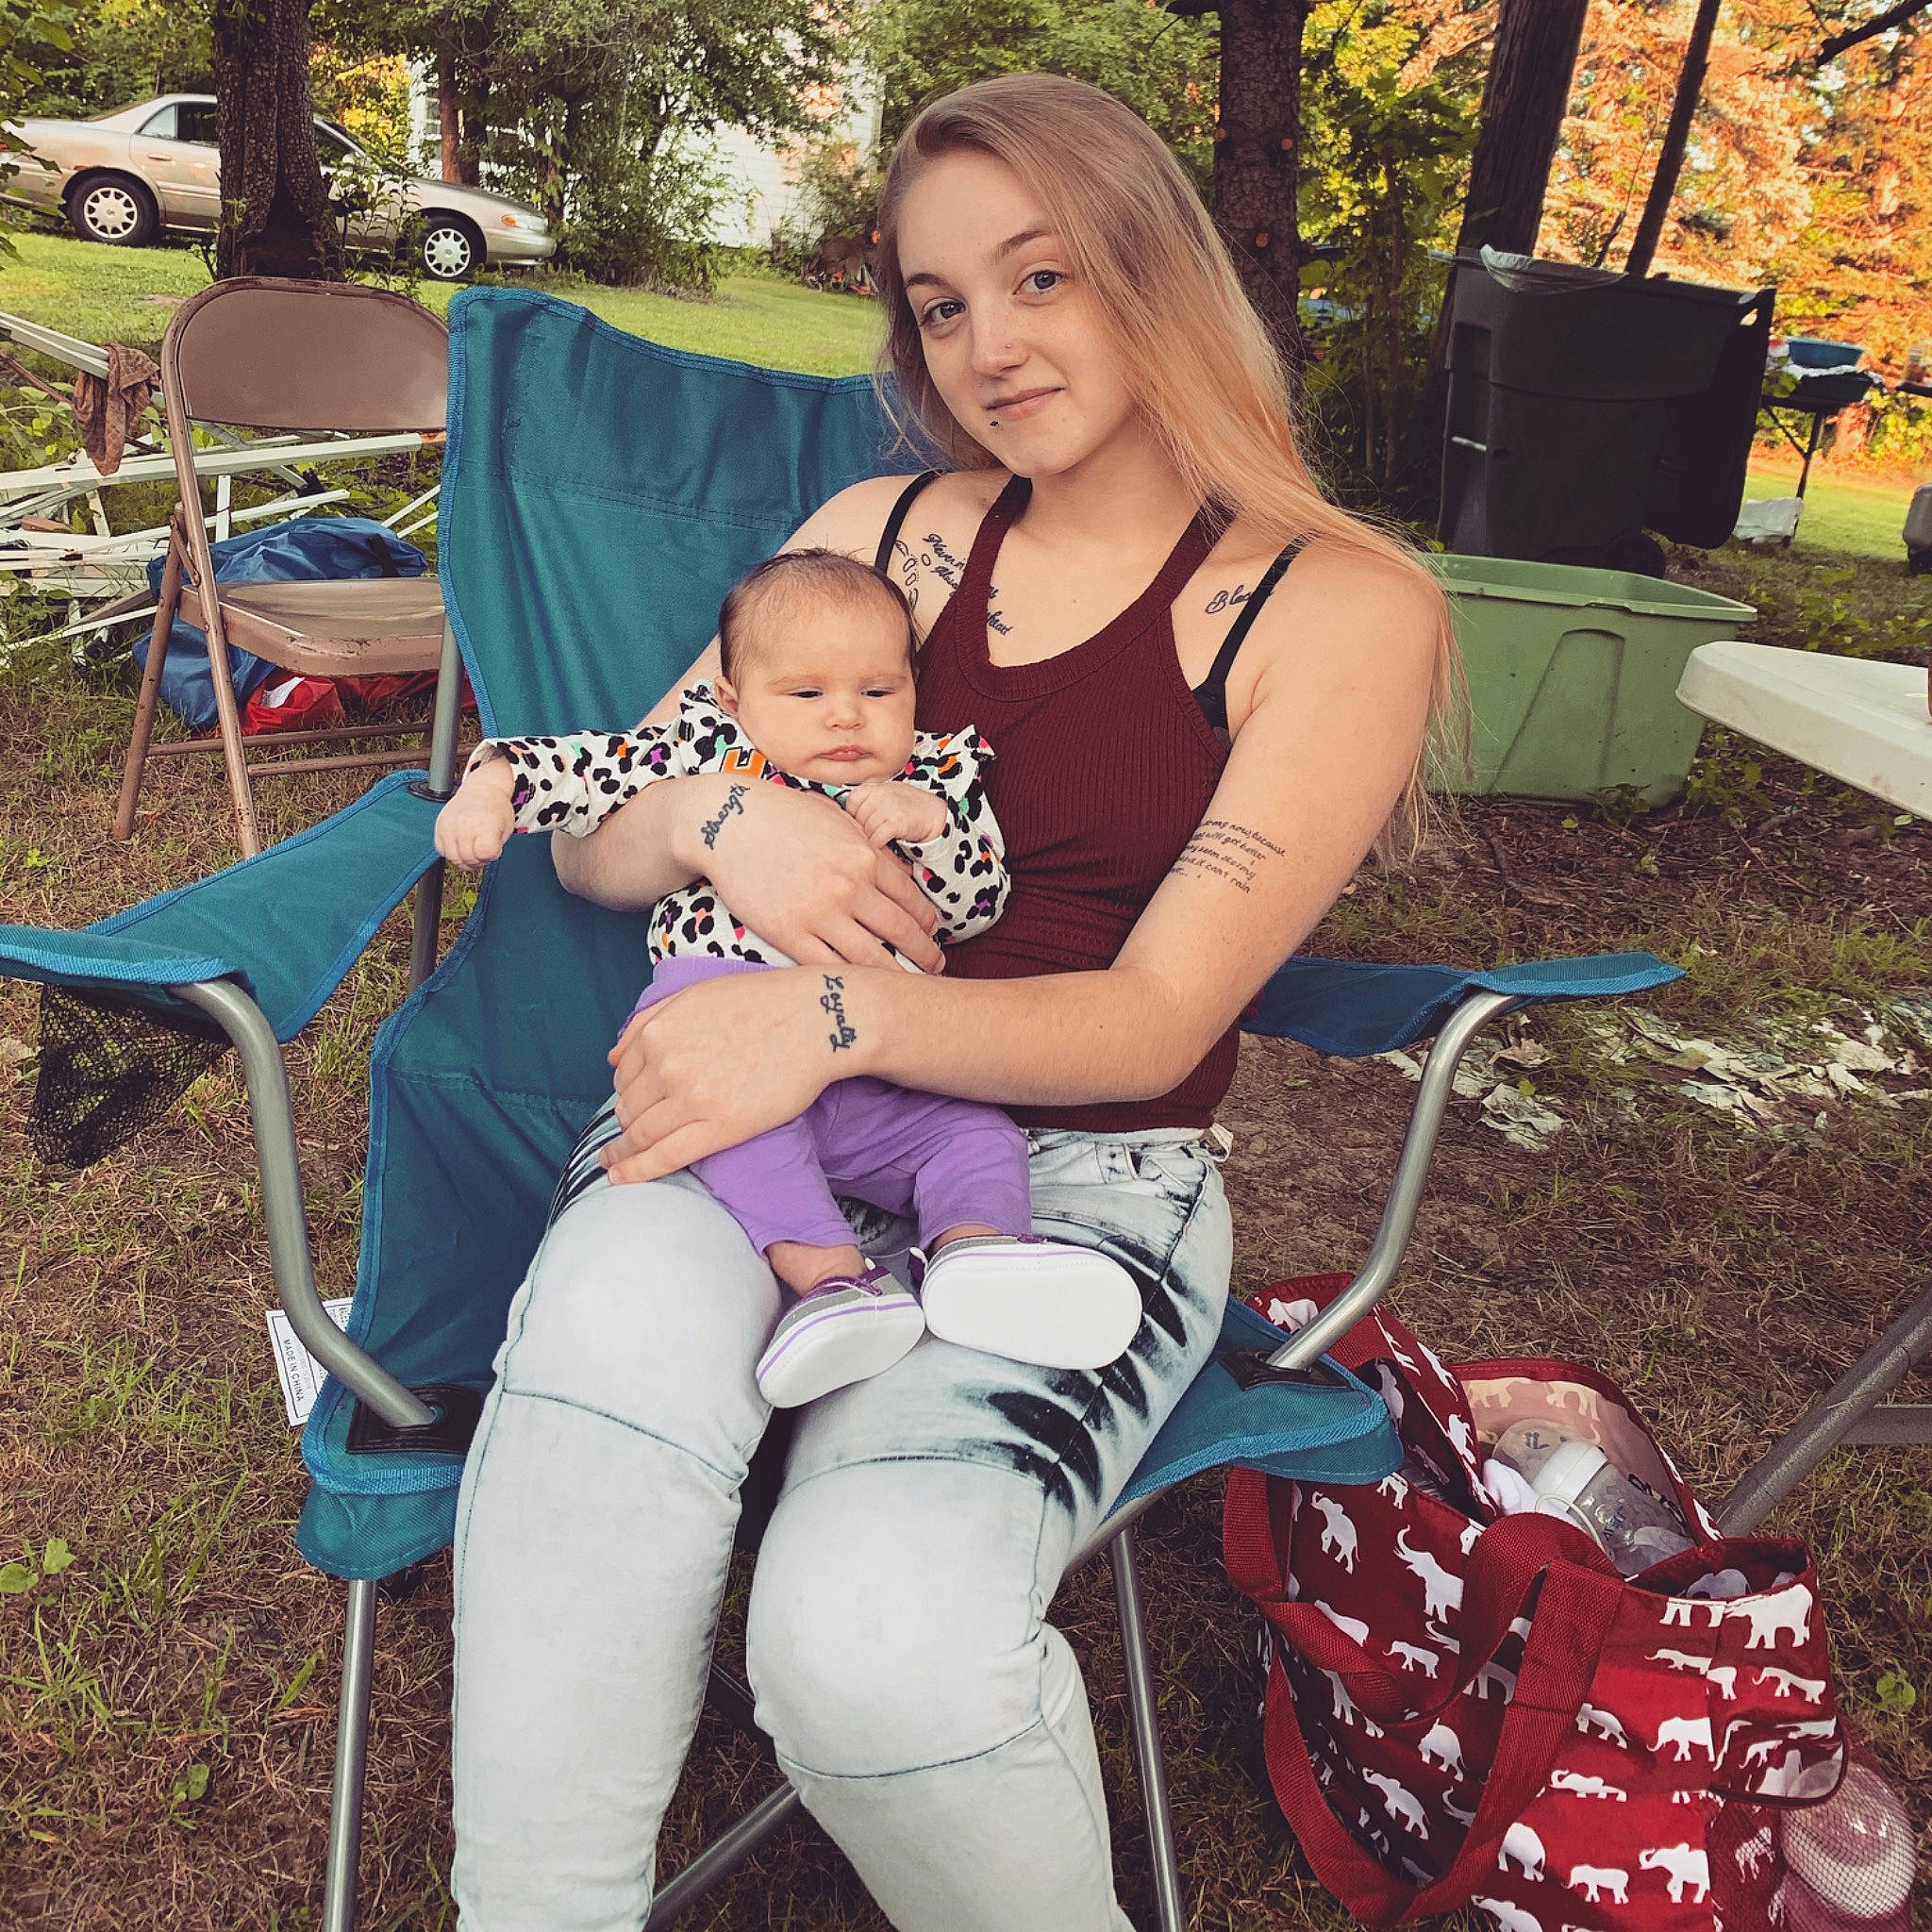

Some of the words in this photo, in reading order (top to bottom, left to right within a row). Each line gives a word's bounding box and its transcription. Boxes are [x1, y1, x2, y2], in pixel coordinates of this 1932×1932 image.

[702, 784, 750, 850] Strength
[1229, 877, 1251, 893] rain
[820, 974, 857, 1052] Loyalty
[283, 1339, 296, 1362] MADE
[291, 1374, 304, 1402] CHINA
